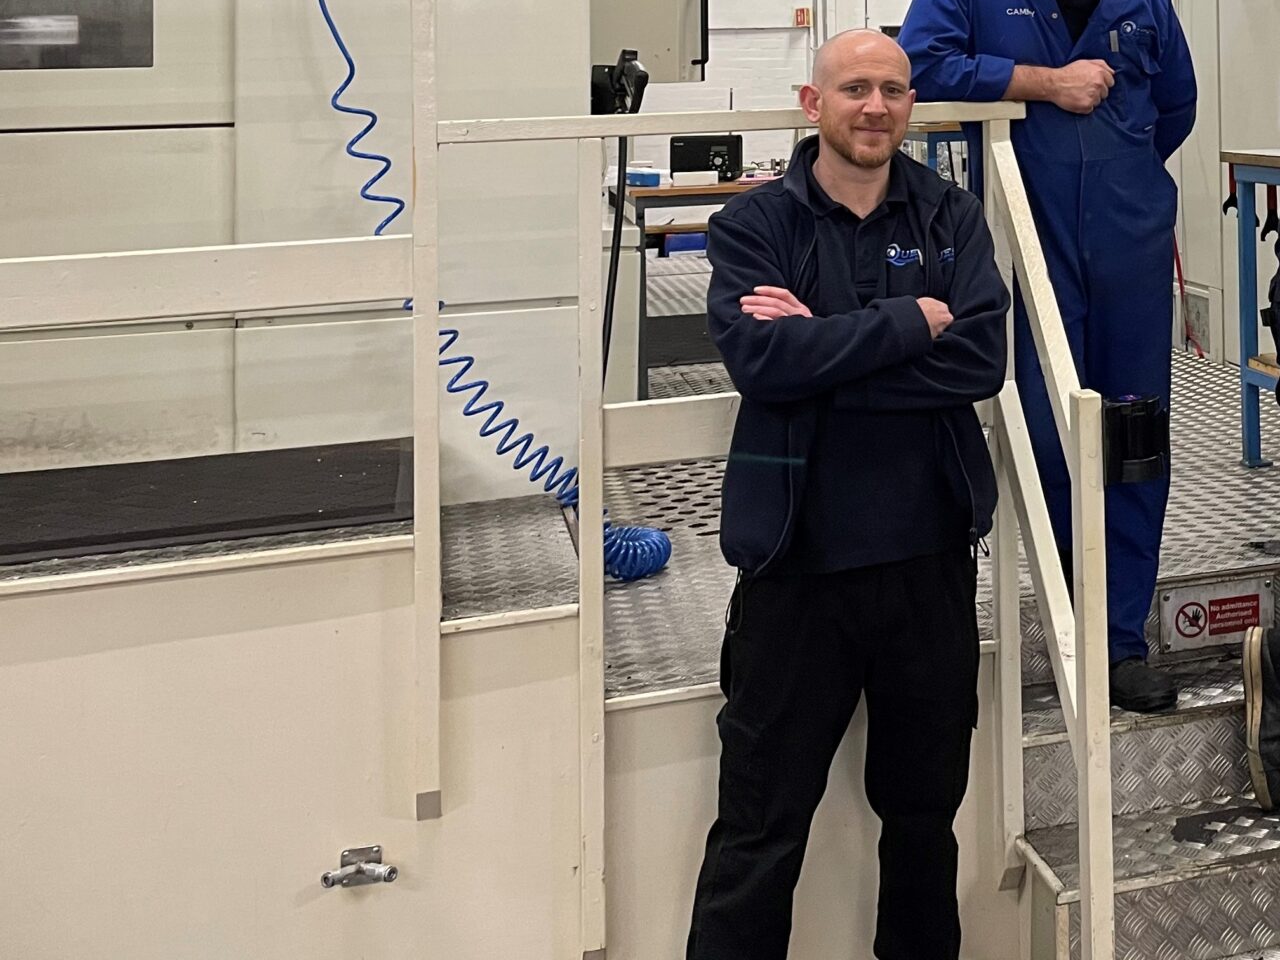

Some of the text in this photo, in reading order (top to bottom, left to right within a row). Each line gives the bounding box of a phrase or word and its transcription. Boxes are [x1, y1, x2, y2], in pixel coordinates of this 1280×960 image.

[1210, 600, 1258, 613] No admittance
[1215, 608, 1253, 620] Authorised
[1209, 616, 1259, 630] personnel only
